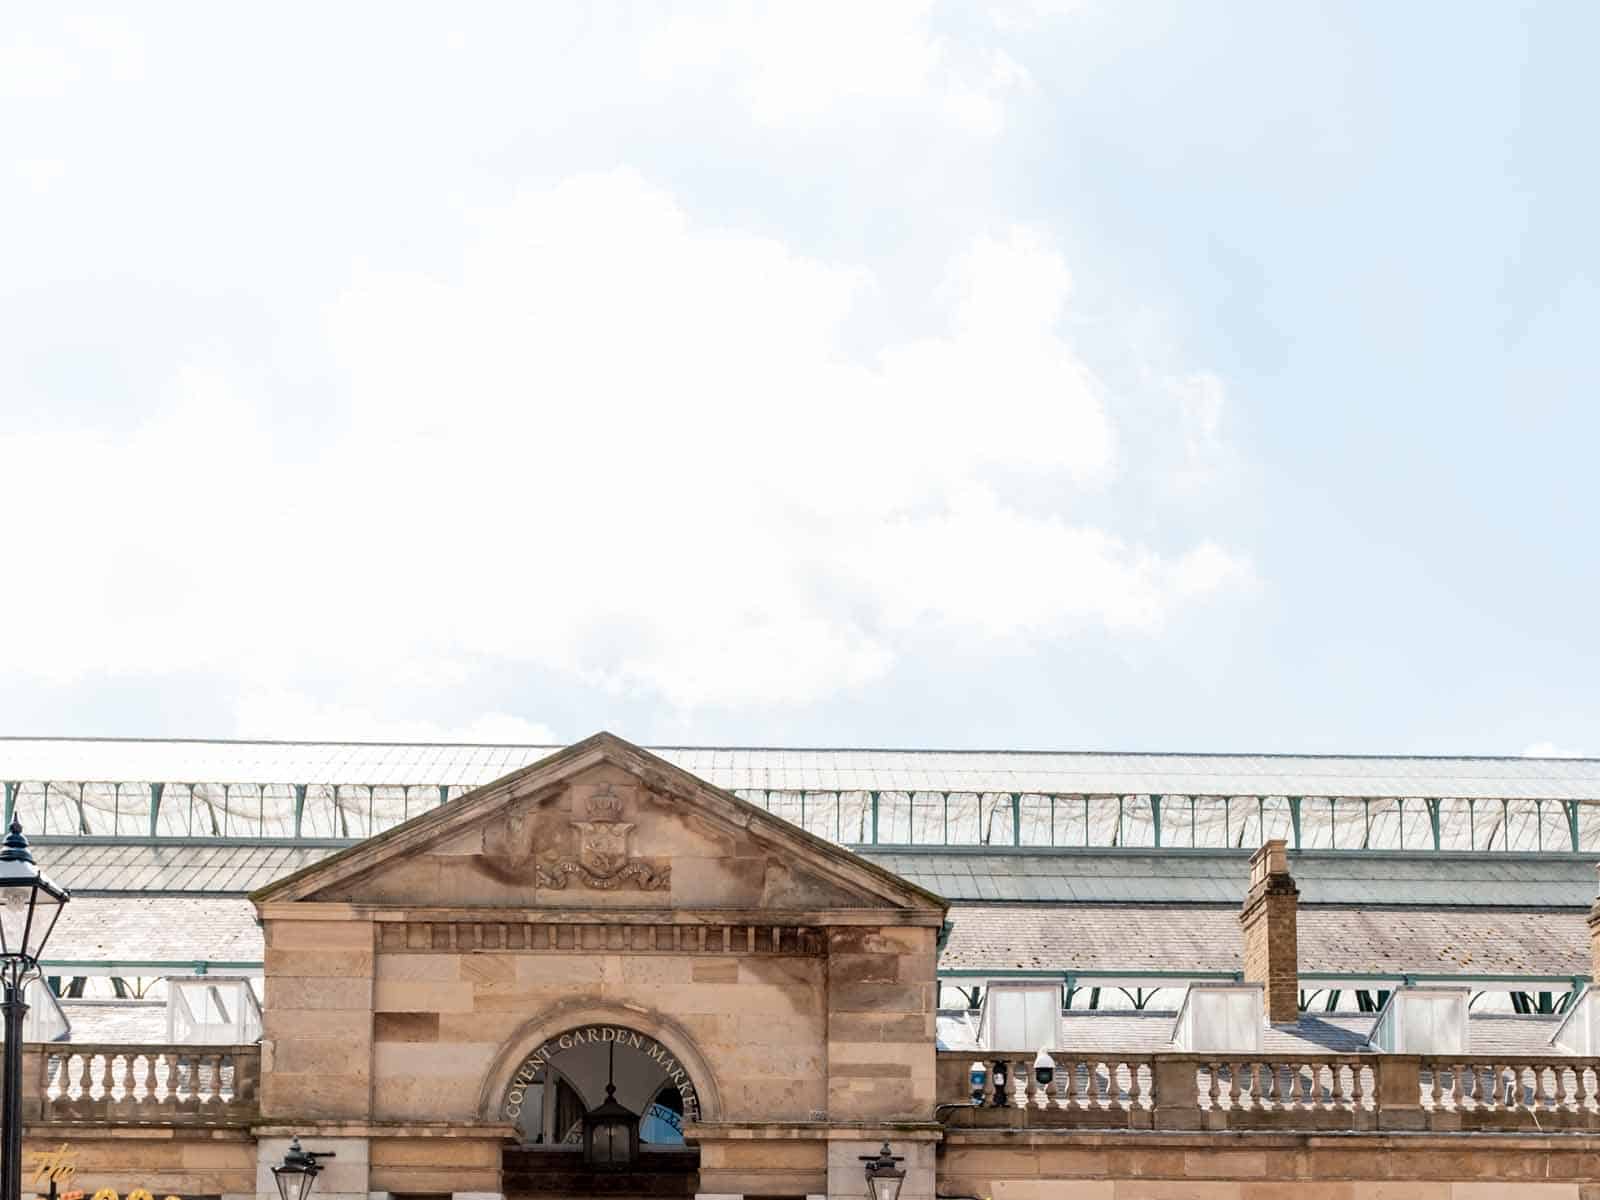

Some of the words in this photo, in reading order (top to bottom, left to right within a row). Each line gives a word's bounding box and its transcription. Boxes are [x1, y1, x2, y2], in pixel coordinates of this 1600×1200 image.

[505, 1045, 552, 1119] COVENT
[559, 1027, 643, 1050] GARDEN
[647, 1043, 699, 1123] MARKET
